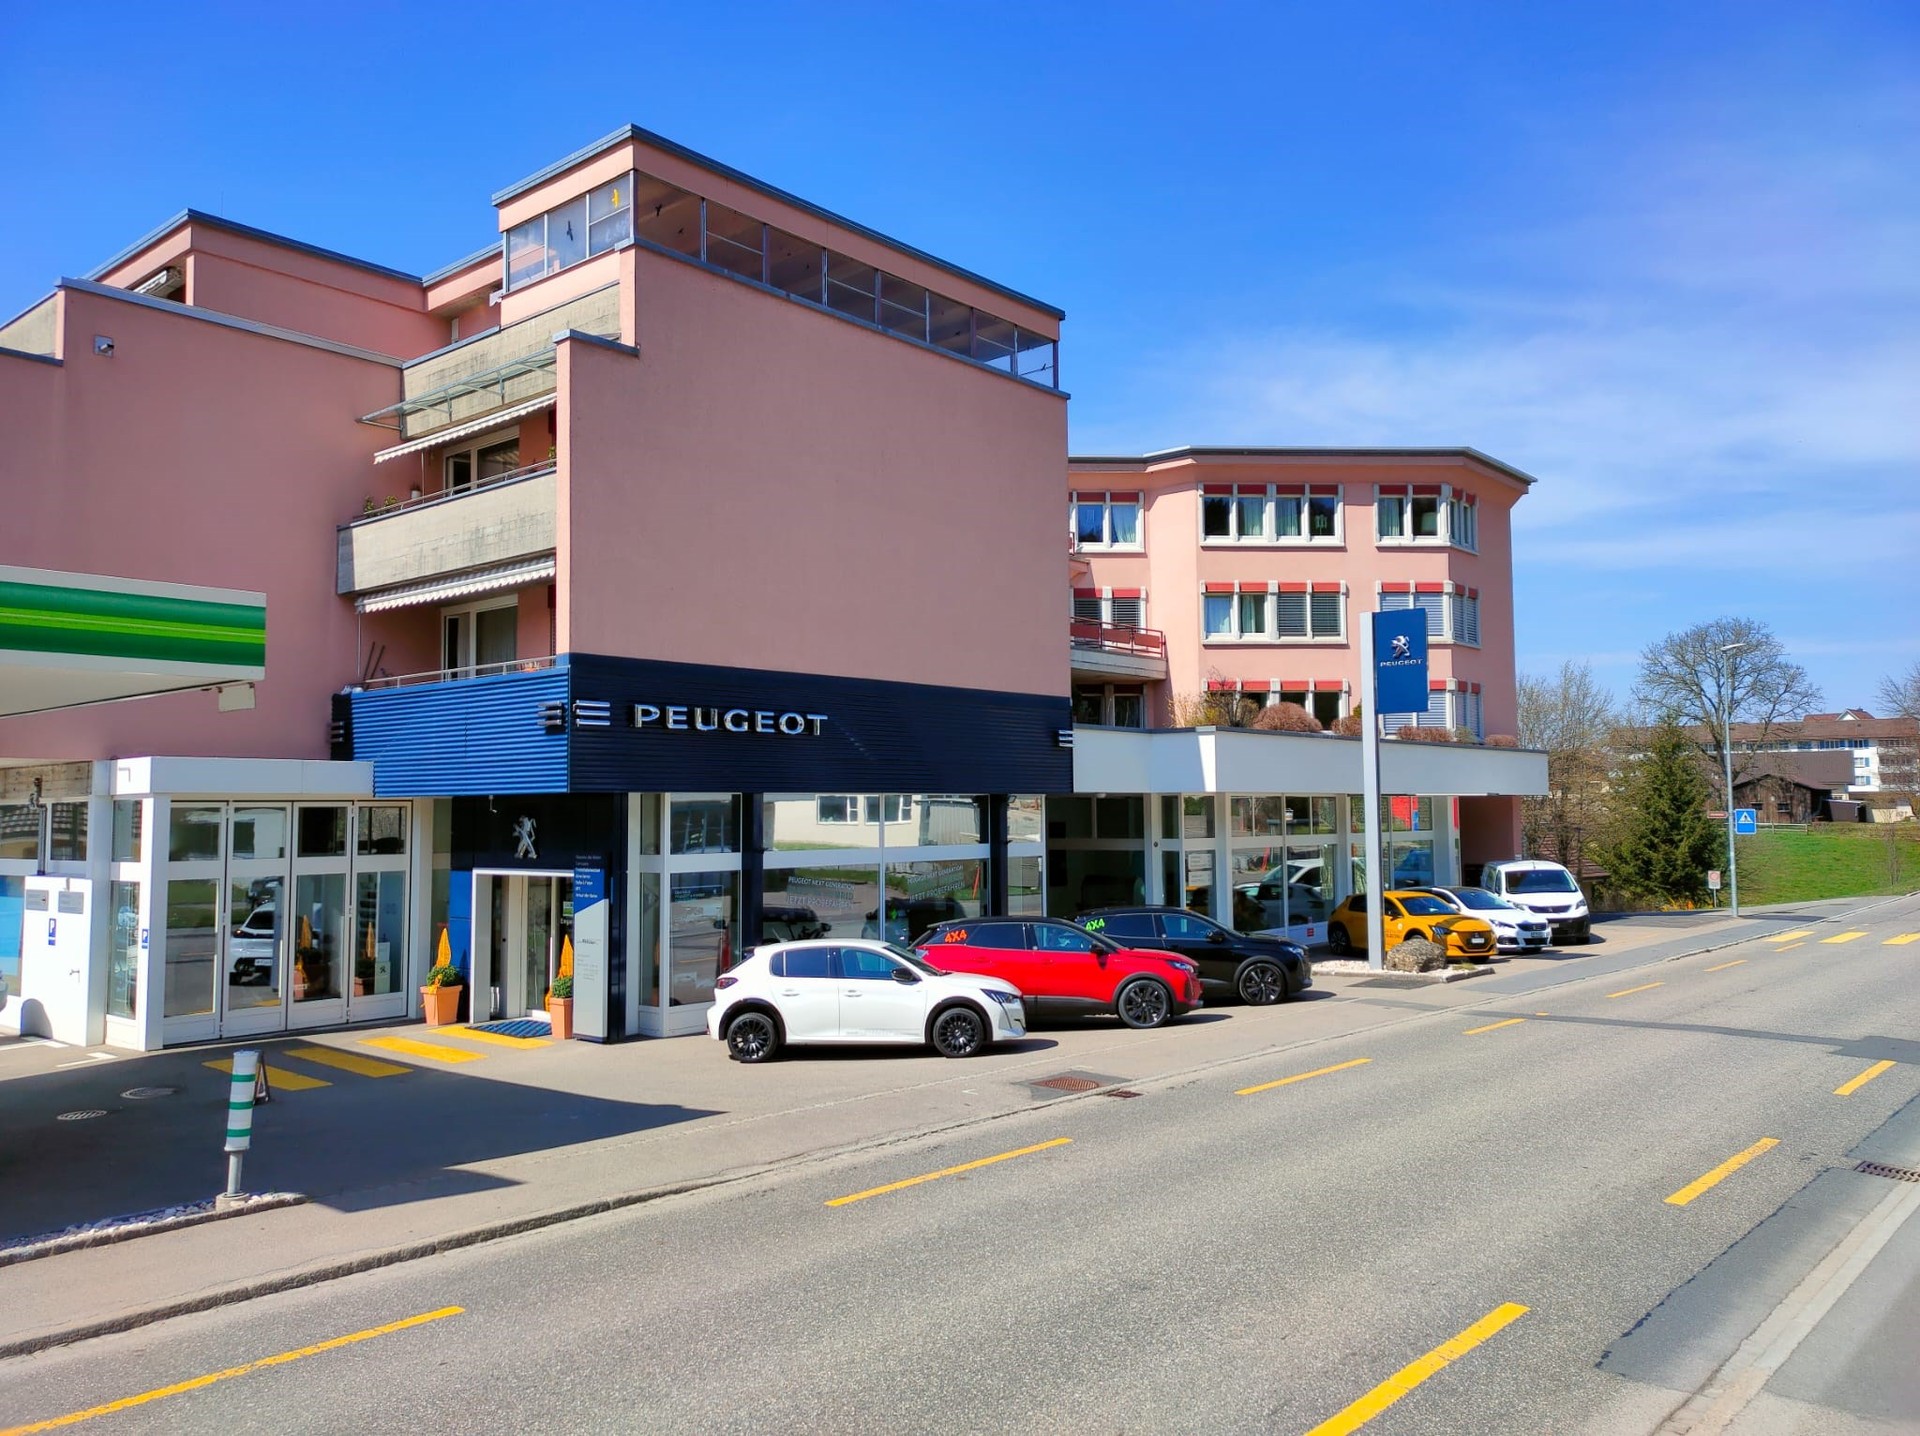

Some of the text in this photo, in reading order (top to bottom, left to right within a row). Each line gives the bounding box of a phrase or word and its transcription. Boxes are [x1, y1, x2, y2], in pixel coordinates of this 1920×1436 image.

[1380, 659, 1423, 667] PEUGEOT
[634, 703, 828, 736] PEUGEOT
[1085, 918, 1106, 931] 4X4
[944, 929, 968, 943] 4X4
